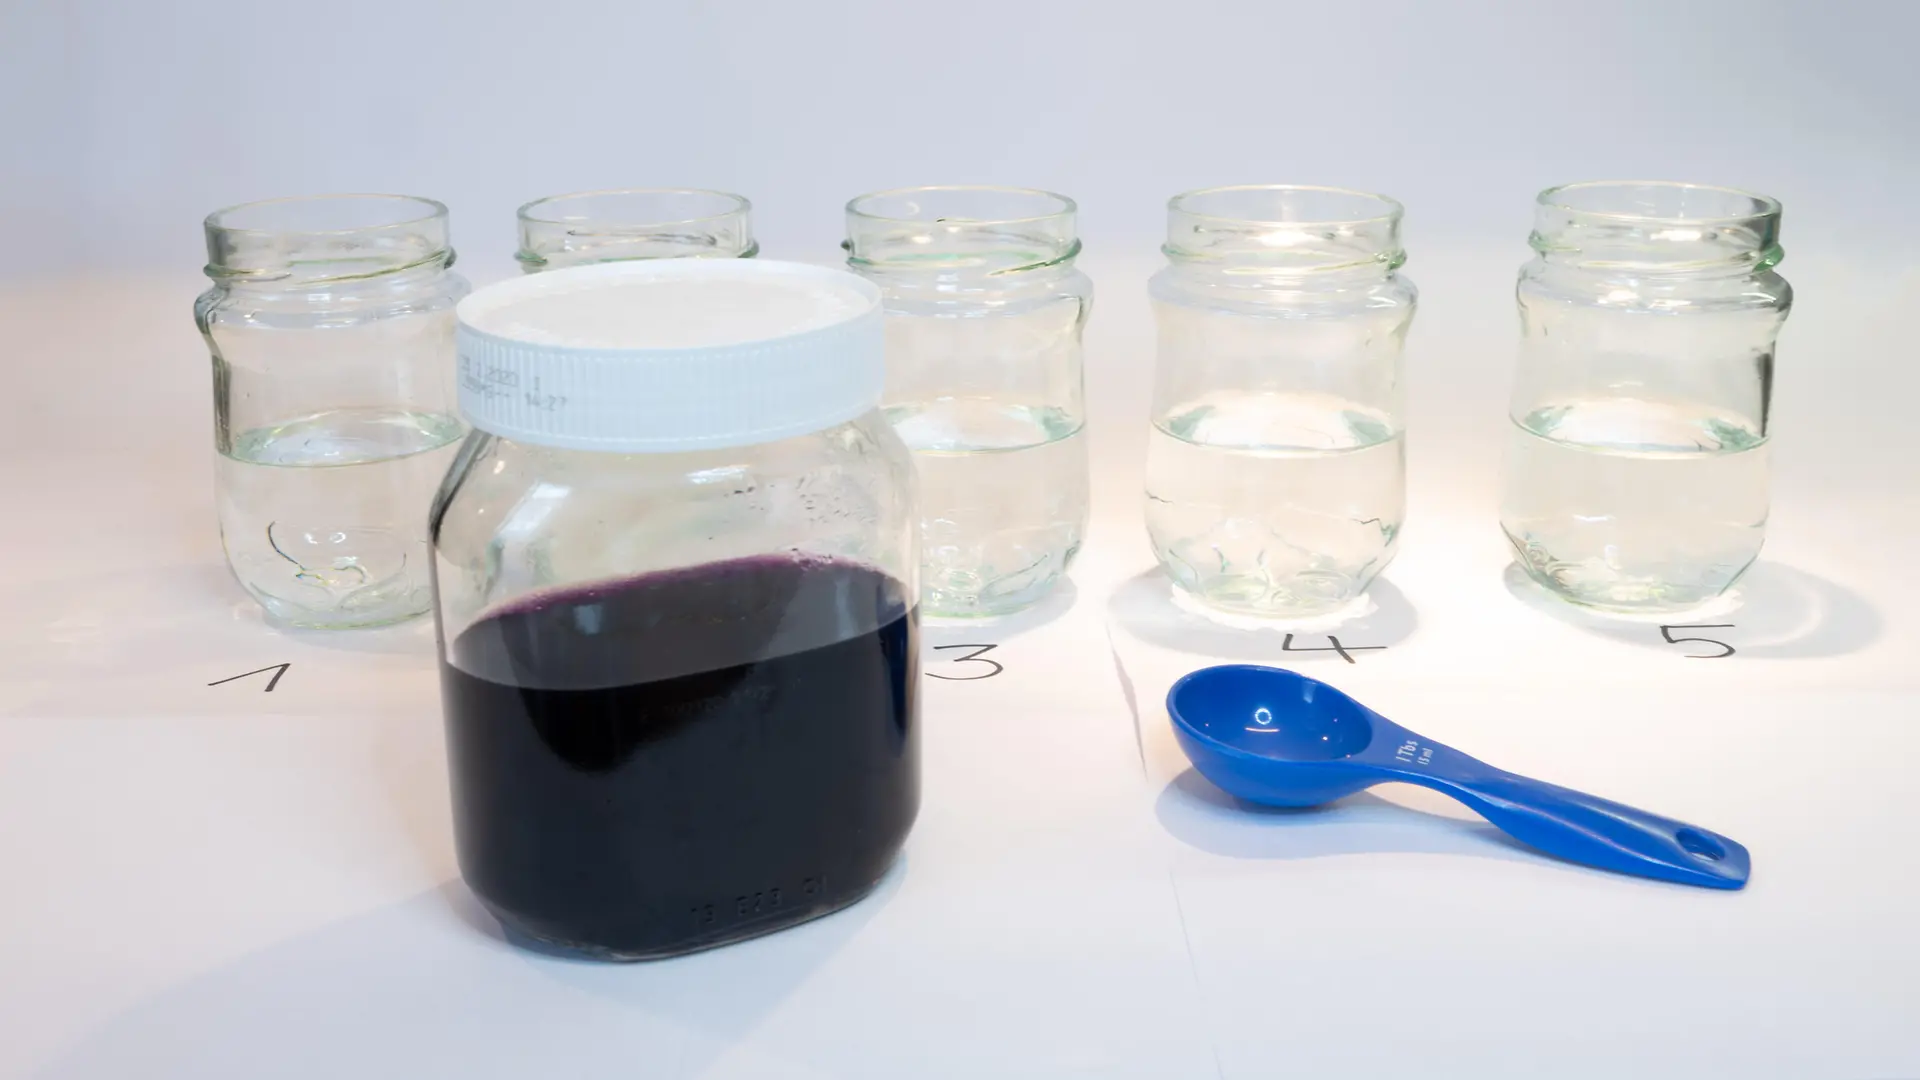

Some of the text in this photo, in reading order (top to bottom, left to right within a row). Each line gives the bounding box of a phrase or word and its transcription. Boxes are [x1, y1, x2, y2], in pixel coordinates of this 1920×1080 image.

[1281, 633, 1387, 664] 4
[1659, 624, 1736, 658] 5
[207, 662, 291, 693] 1
[926, 644, 1003, 680] 3
[1397, 740, 1419, 757] Tbs
